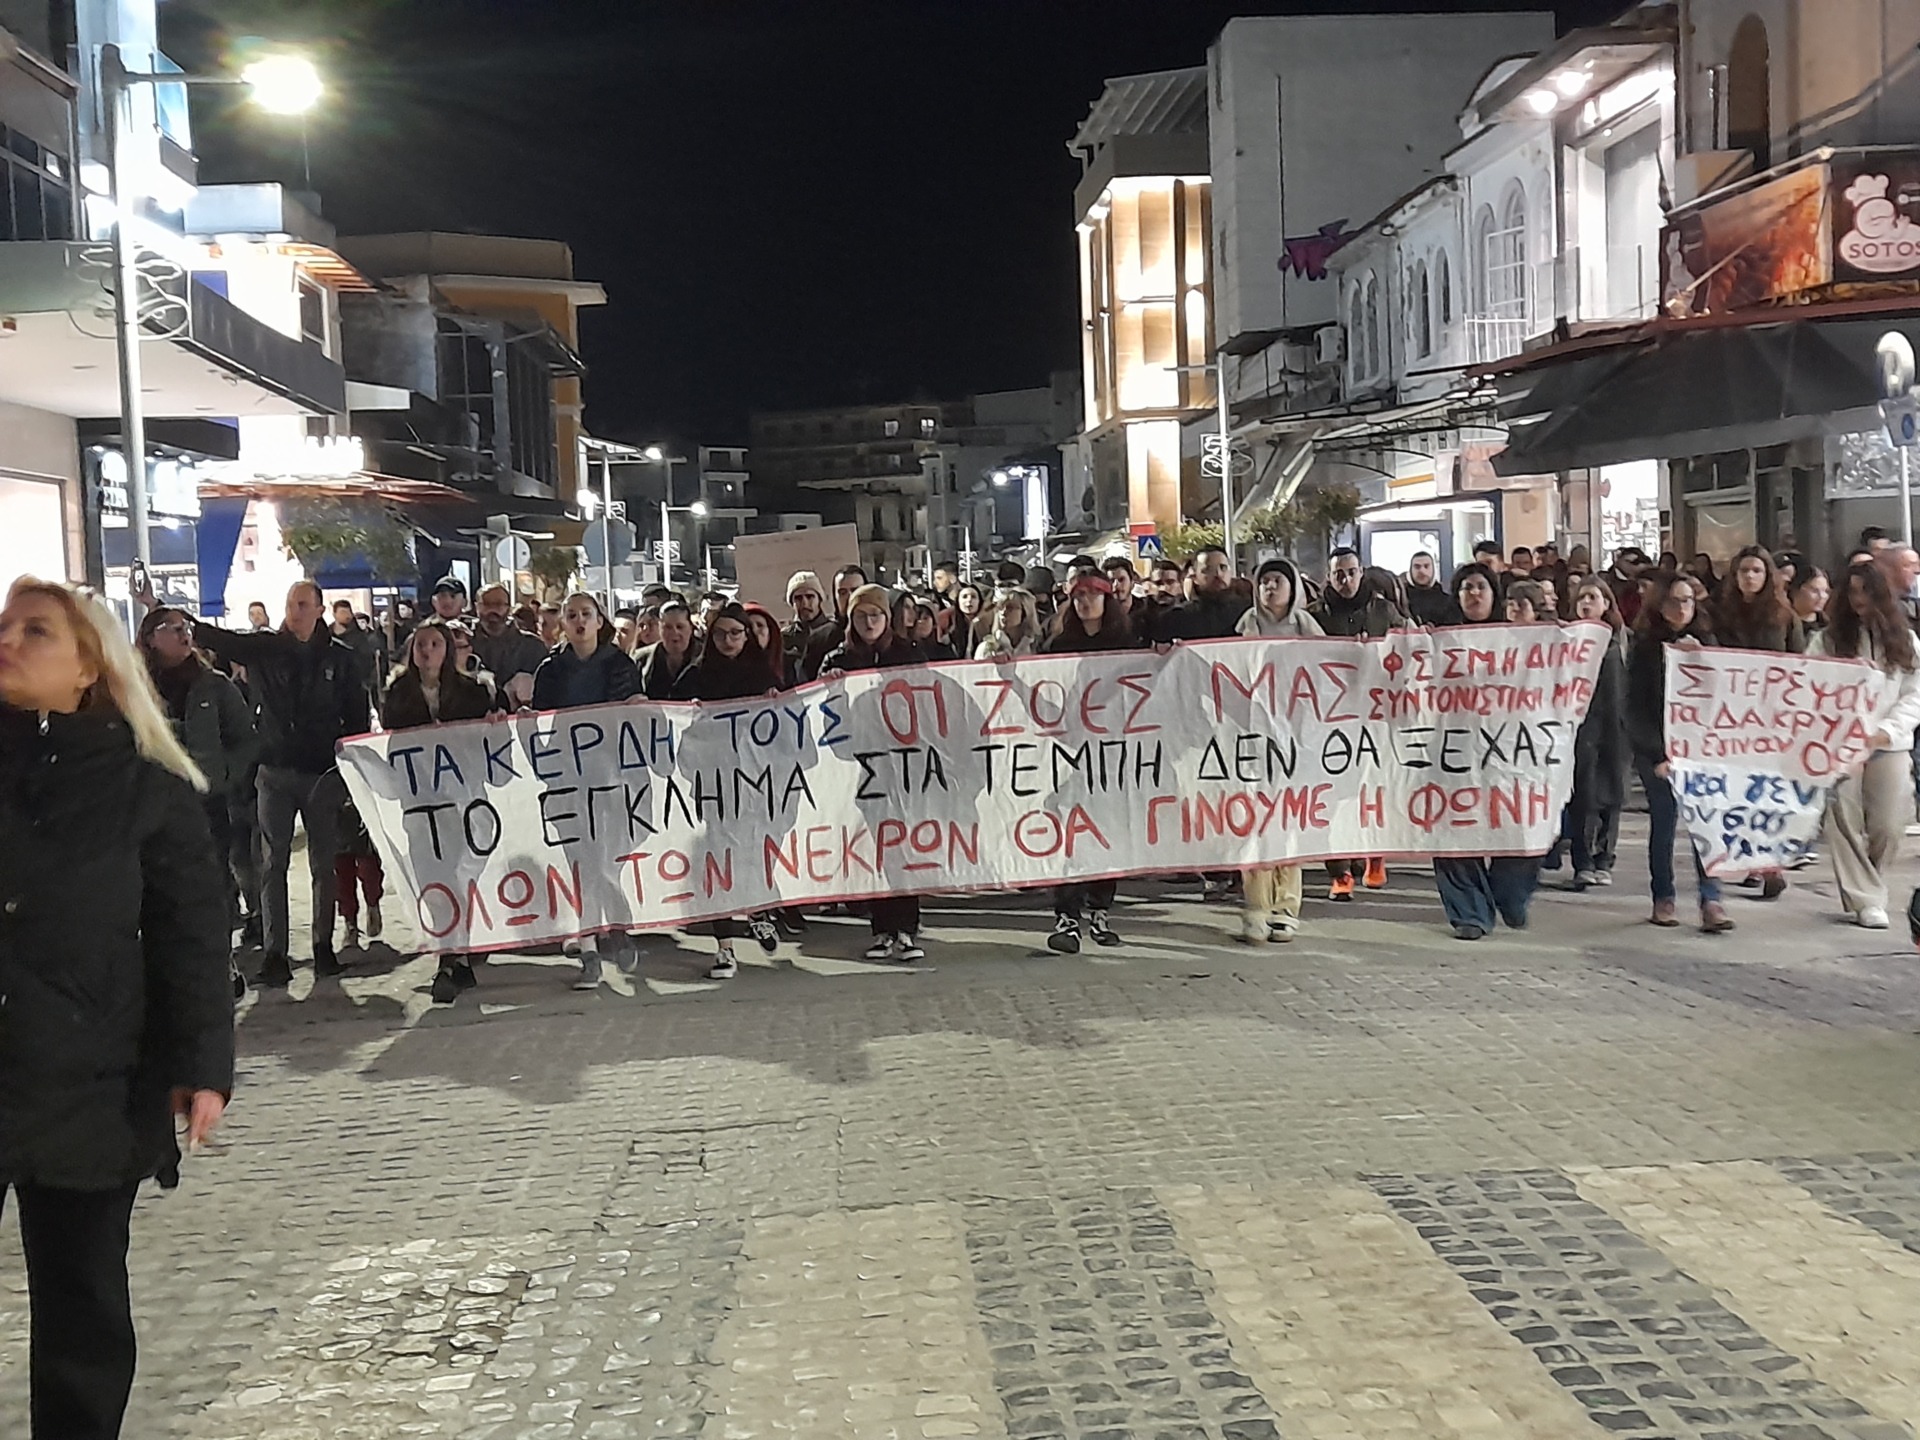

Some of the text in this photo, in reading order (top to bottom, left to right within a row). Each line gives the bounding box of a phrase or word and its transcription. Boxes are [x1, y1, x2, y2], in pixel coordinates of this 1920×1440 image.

[389, 743, 464, 797] ΤΑ
[483, 718, 675, 784] ΚΕΡΔΗ
[713, 695, 852, 753] ΤΟΥΣ
[1211, 660, 1359, 724] ΜΑΣ
[403, 720, 1574, 861] ΤΟ ΕΓΚΛΗΜΑ ΣΤΑ ΤΕΜΠΗ ΔΕΝ ΘΑ ΞΕΧΑΣ
[763, 819, 979, 891] ΝΕΚΡΩΝ
[1014, 803, 1110, 858] ΘΑ
[1147, 783, 1333, 845] ΓΙΝΟΥΜΕ
[1360, 783, 1386, 829] Η
[1408, 778, 1549, 834] ΦΩΝΗ
